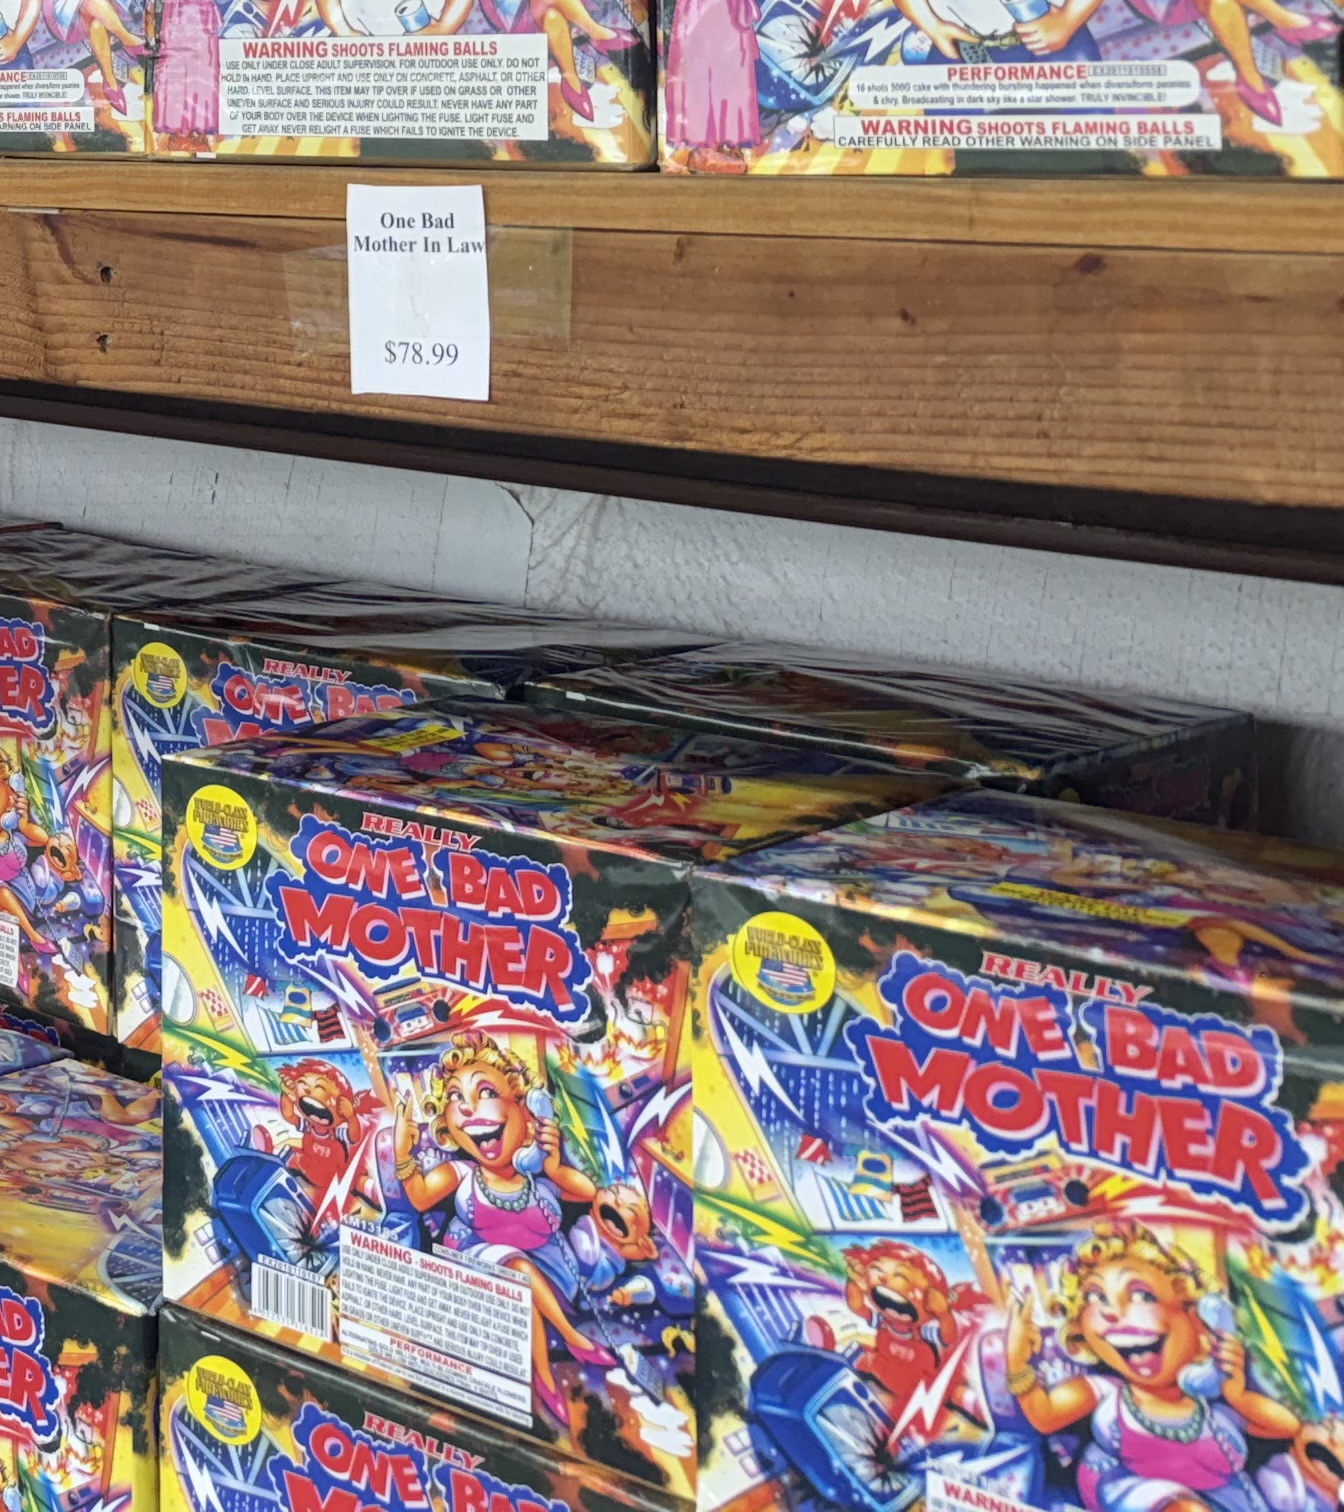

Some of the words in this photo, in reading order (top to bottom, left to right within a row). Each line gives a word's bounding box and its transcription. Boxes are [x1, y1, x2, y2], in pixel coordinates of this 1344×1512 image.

[243, 41, 328, 59] WARNING
[331, 43, 385, 58] SHOOTS
[387, 41, 449, 57] FLAMING
[452, 41, 498, 56] BALLS
[947, 64, 1088, 82] PERFORMANCE
[7, 112, 48, 123] FLAMING
[51, 111, 81, 122] BALLS
[862, 119, 973, 137] WARNING
[977, 121, 1046, 137] SHOOTS
[1051, 120, 1131, 136] FLAMING
[1137, 120, 1195, 136] BALLS
[838, 136, 918, 148] CAREFULLY
[922, 136, 963, 148] READ
[966, 136, 1017, 148] OTHER
[1021, 136, 1092, 148] WARNING
[1096, 136, 1117, 148] ON
[1122, 136, 1157, 148] SIDE
[1163, 136, 1215, 148] PANEL
[379, 211, 417, 230] One
[420, 211, 456, 230] Bad
[352, 234, 418, 254] Mother
[423, 235, 442, 254] In
[446, 235, 485, 255] Law
[383, 339, 460, 367] $78.99
[360, 812, 482, 851] REALLY
[305, 831, 426, 899] ONE
[445, 852, 563, 921] BAD
[276, 886, 577, 1012] MOTHER
[980, 950, 1152, 1007] REALLY
[902, 971, 1075, 1064] ONE
[1103, 1007, 1269, 1097] BAD
[865, 1032, 1296, 1213] MOTHER
[350, 1231, 413, 1265] WARNING
[419, 1257, 454, 1279] SHOOTS
[455, 1268, 495, 1292] FLAMING
[495, 1279, 524, 1304] BALLS
[388, 1336, 474, 1376] PERFORMANCE
